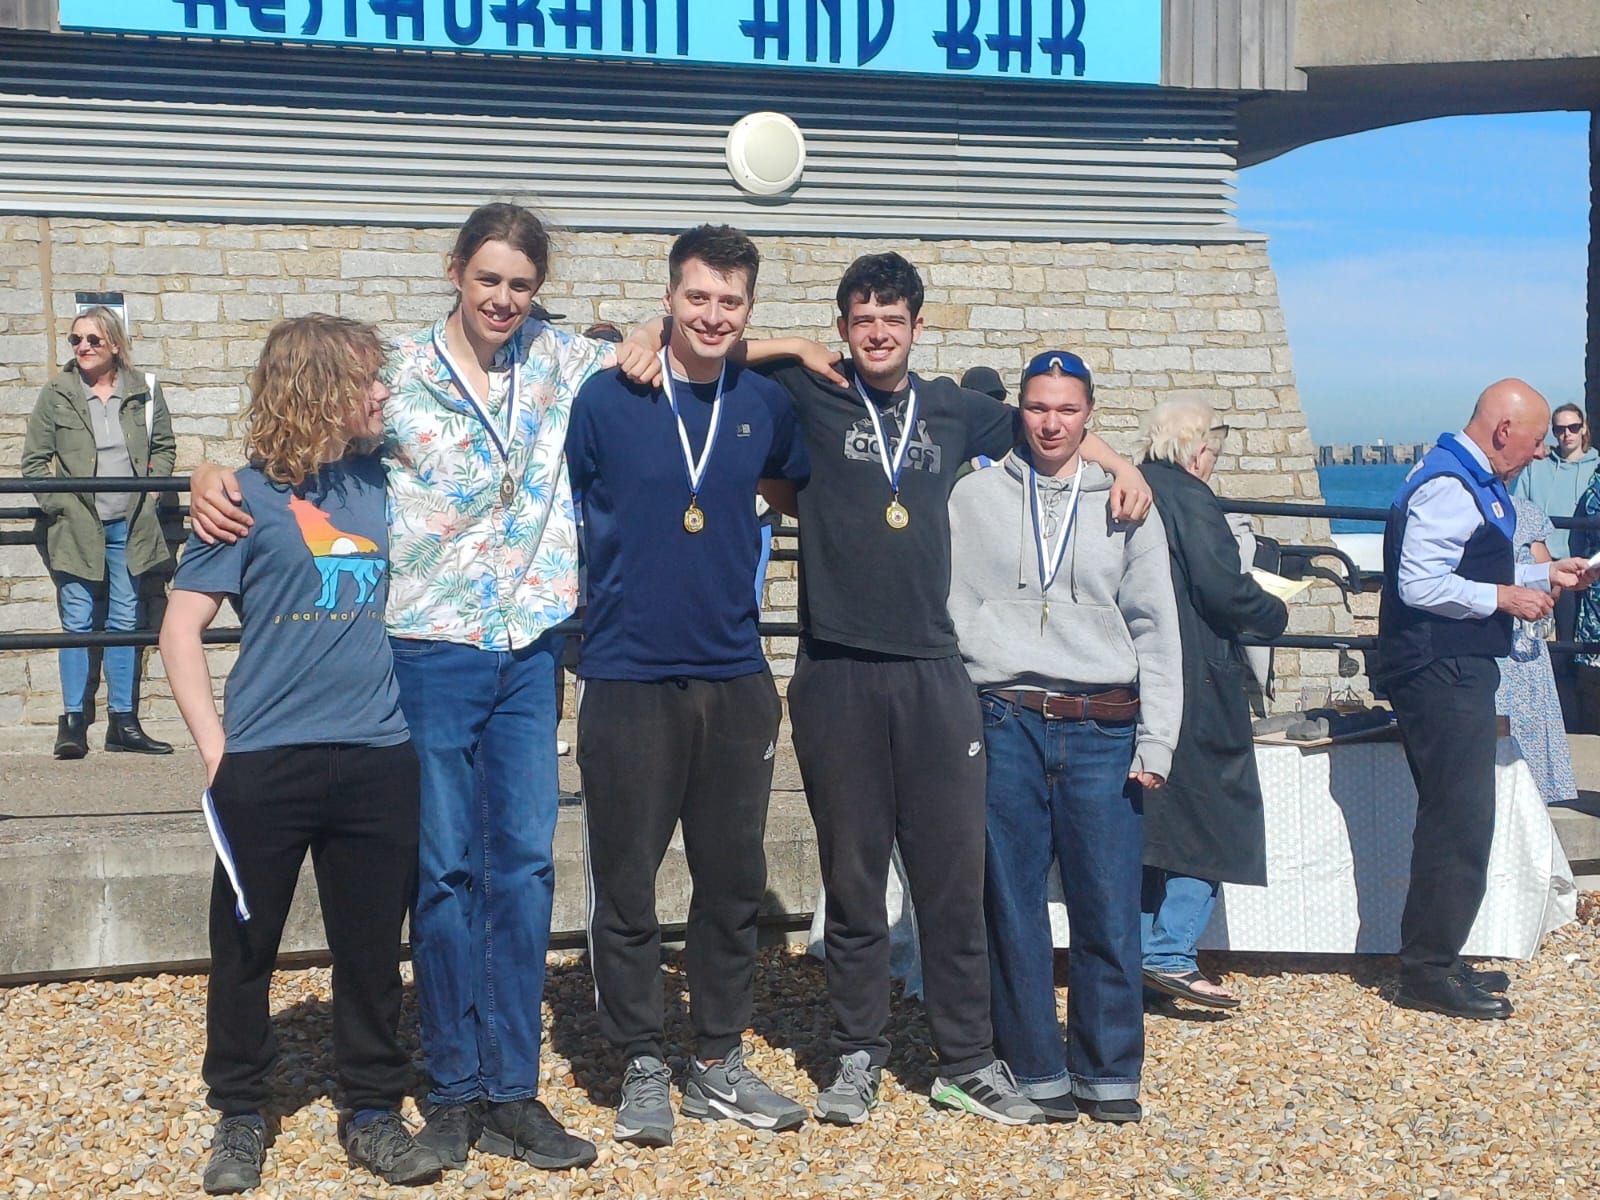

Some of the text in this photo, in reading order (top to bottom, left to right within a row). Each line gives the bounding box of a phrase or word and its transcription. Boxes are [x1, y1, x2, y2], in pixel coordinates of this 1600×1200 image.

[172, 0, 1086, 77] URANT AND BAR
[852, 436, 936, 466] adas
[329, 610, 357, 621] wol
